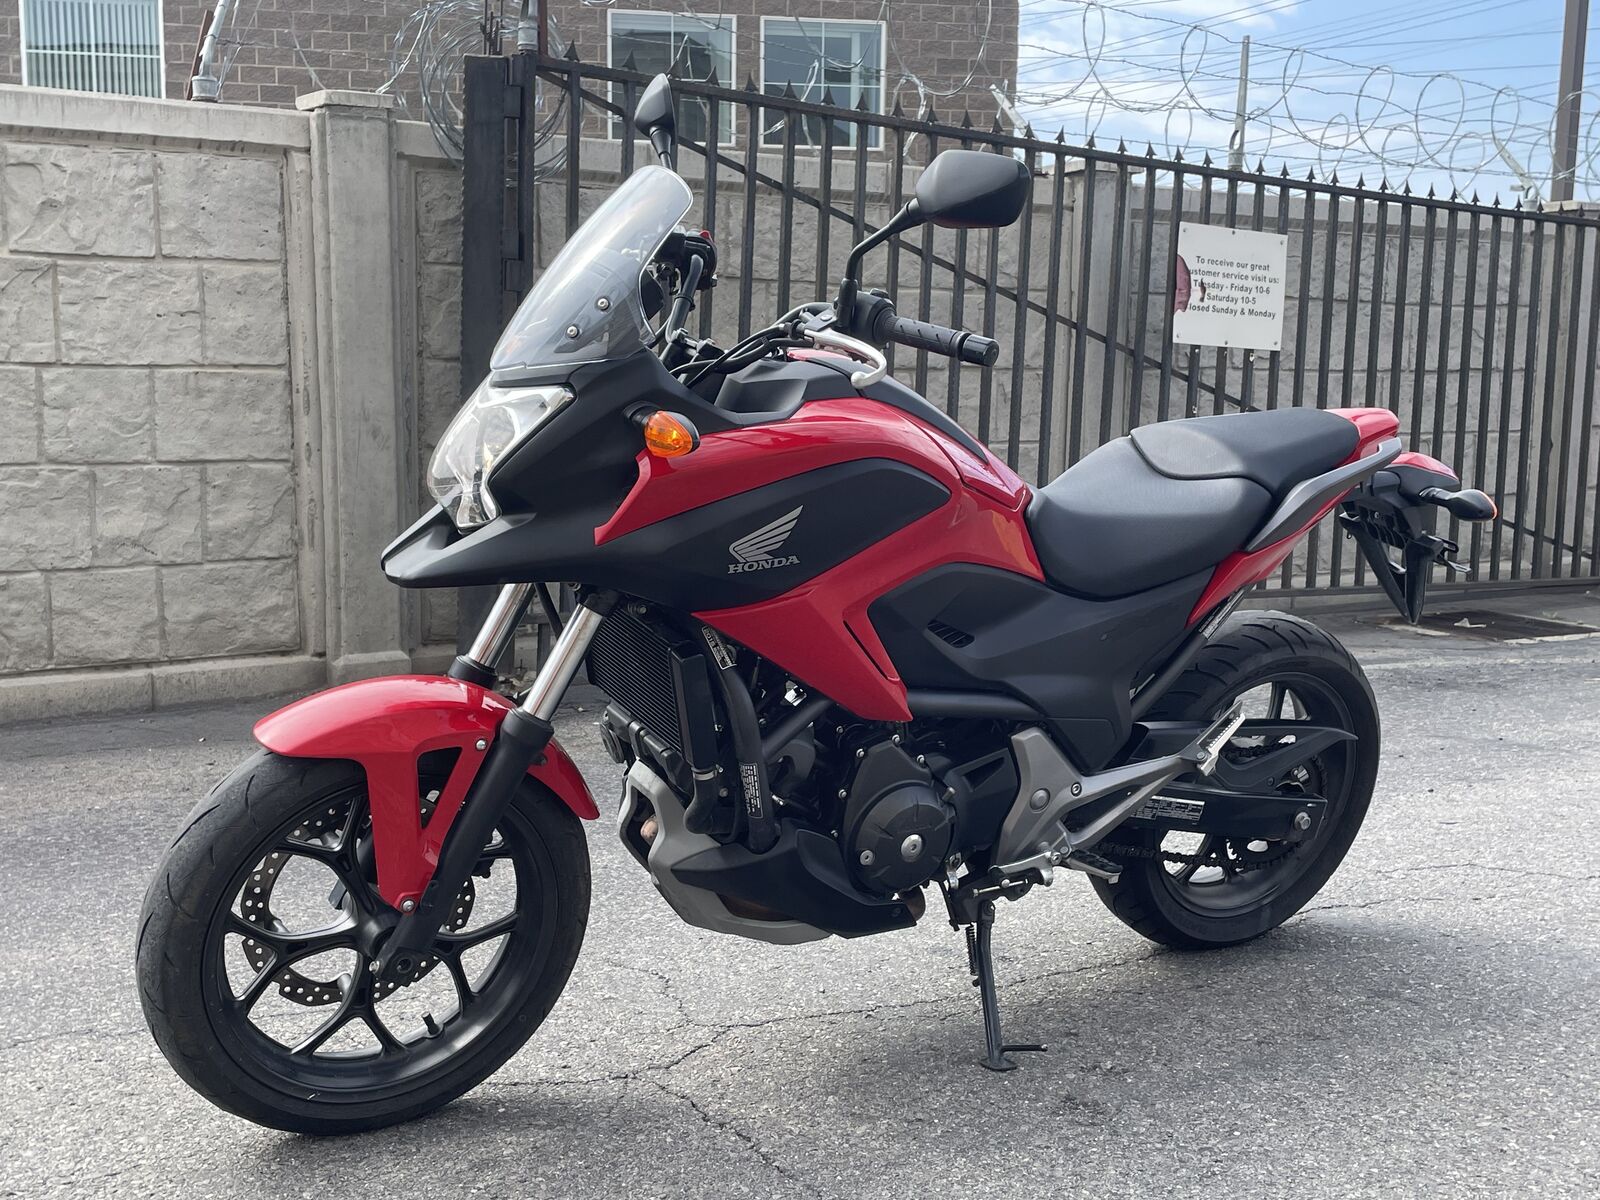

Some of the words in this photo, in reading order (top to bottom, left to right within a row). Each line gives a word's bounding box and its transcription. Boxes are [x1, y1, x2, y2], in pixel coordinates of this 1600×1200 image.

[1196, 256, 1205, 264] To
[1208, 259, 1234, 267] receive
[1190, 269, 1220, 277] ustomer
[1222, 272, 1249, 280] service
[1251, 274, 1266, 282] visit
[1230, 283, 1253, 294] Friday
[1256, 285, 1270, 294] 10-6
[1207, 292, 1238, 304] Saturday
[1241, 296, 1256, 304] 10-5
[1189, 303, 1210, 312] losed
[1211, 304, 1238, 316] Sunday
[1248, 308, 1276, 319] Monday
[728, 555, 800, 574] HONDA
